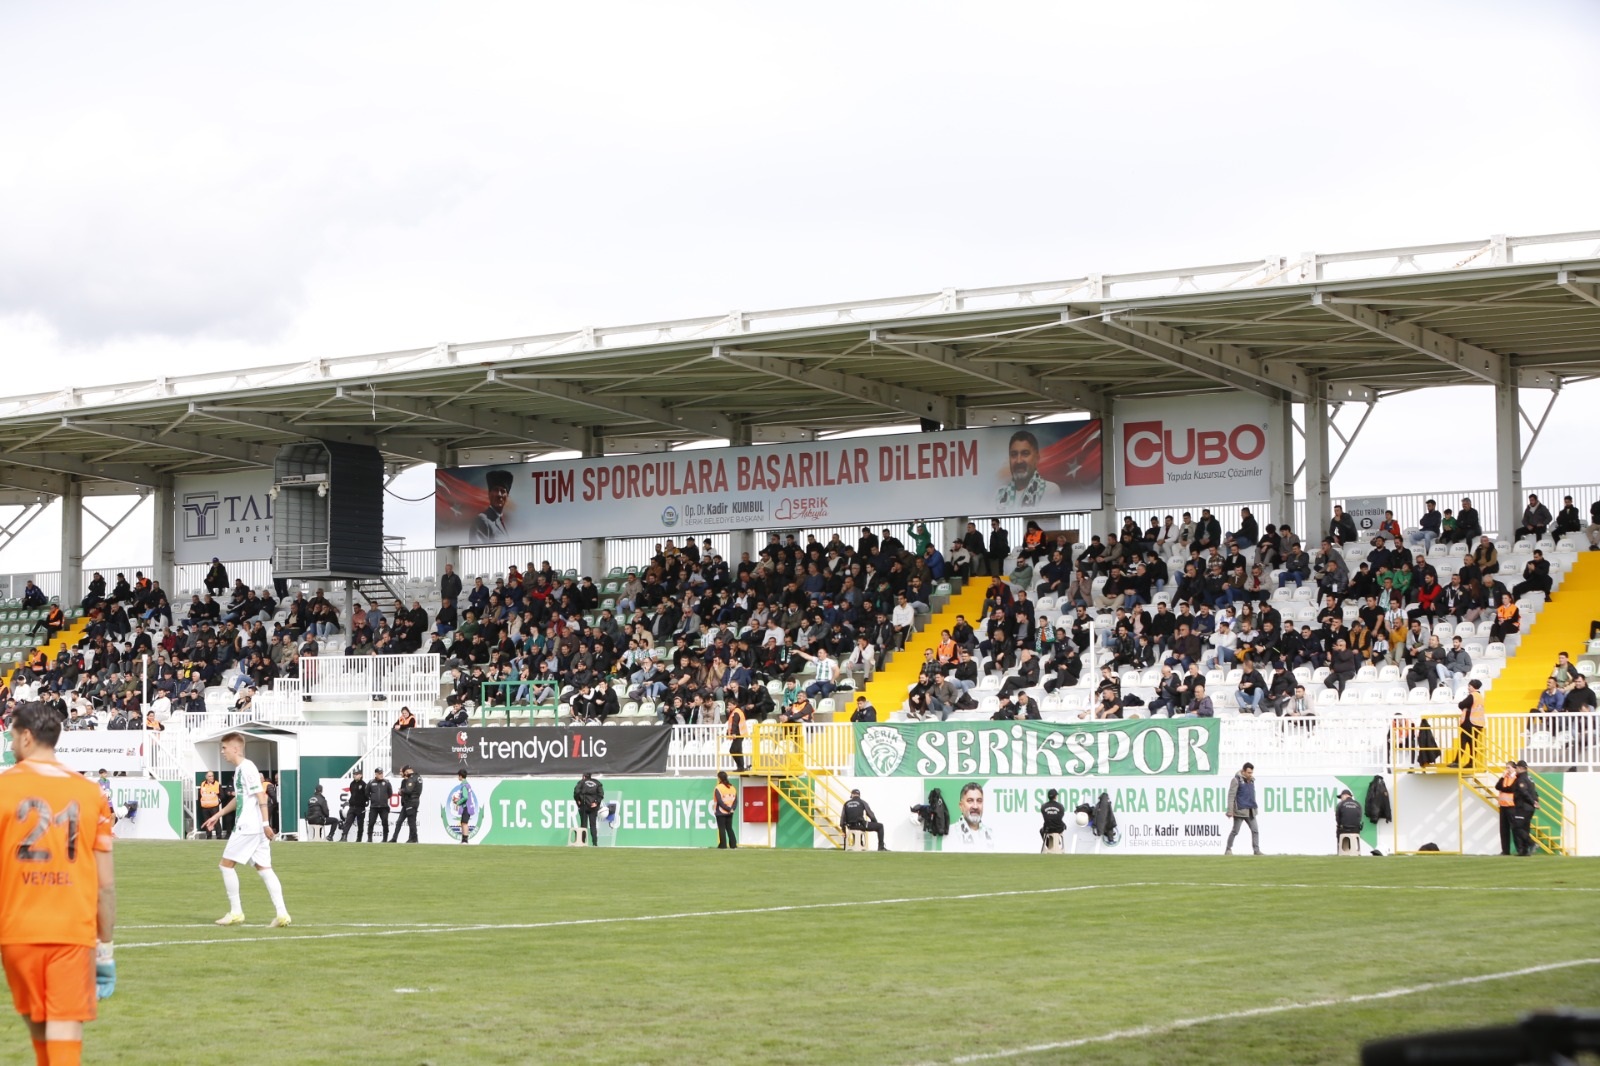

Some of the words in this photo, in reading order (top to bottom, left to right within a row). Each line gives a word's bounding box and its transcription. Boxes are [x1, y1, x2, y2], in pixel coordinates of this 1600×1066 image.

[1126, 424, 1266, 468] CUBO
[531, 469, 575, 505] TÜM
[582, 457, 729, 502] SPORCULARA
[736, 448, 870, 492] BAŞARILAR
[1166, 471, 1192, 485] Yapıda
[1193, 468, 1226, 480] Kusursuz
[1227, 466, 1263, 480] Çözümler
[706, 503, 729, 515] Kadir
[732, 500, 765, 514] KUMBUL
[479, 735, 568, 763] trendyol
[499, 799, 533, 828] T.C.
[993, 788, 1029, 813] TÜM
[17, 797, 80, 864] 21
[1155, 824, 1179, 836] Kadir
[1184, 824, 1222, 837] KUMBUL
[22, 872, 73, 886] VEYSEL
